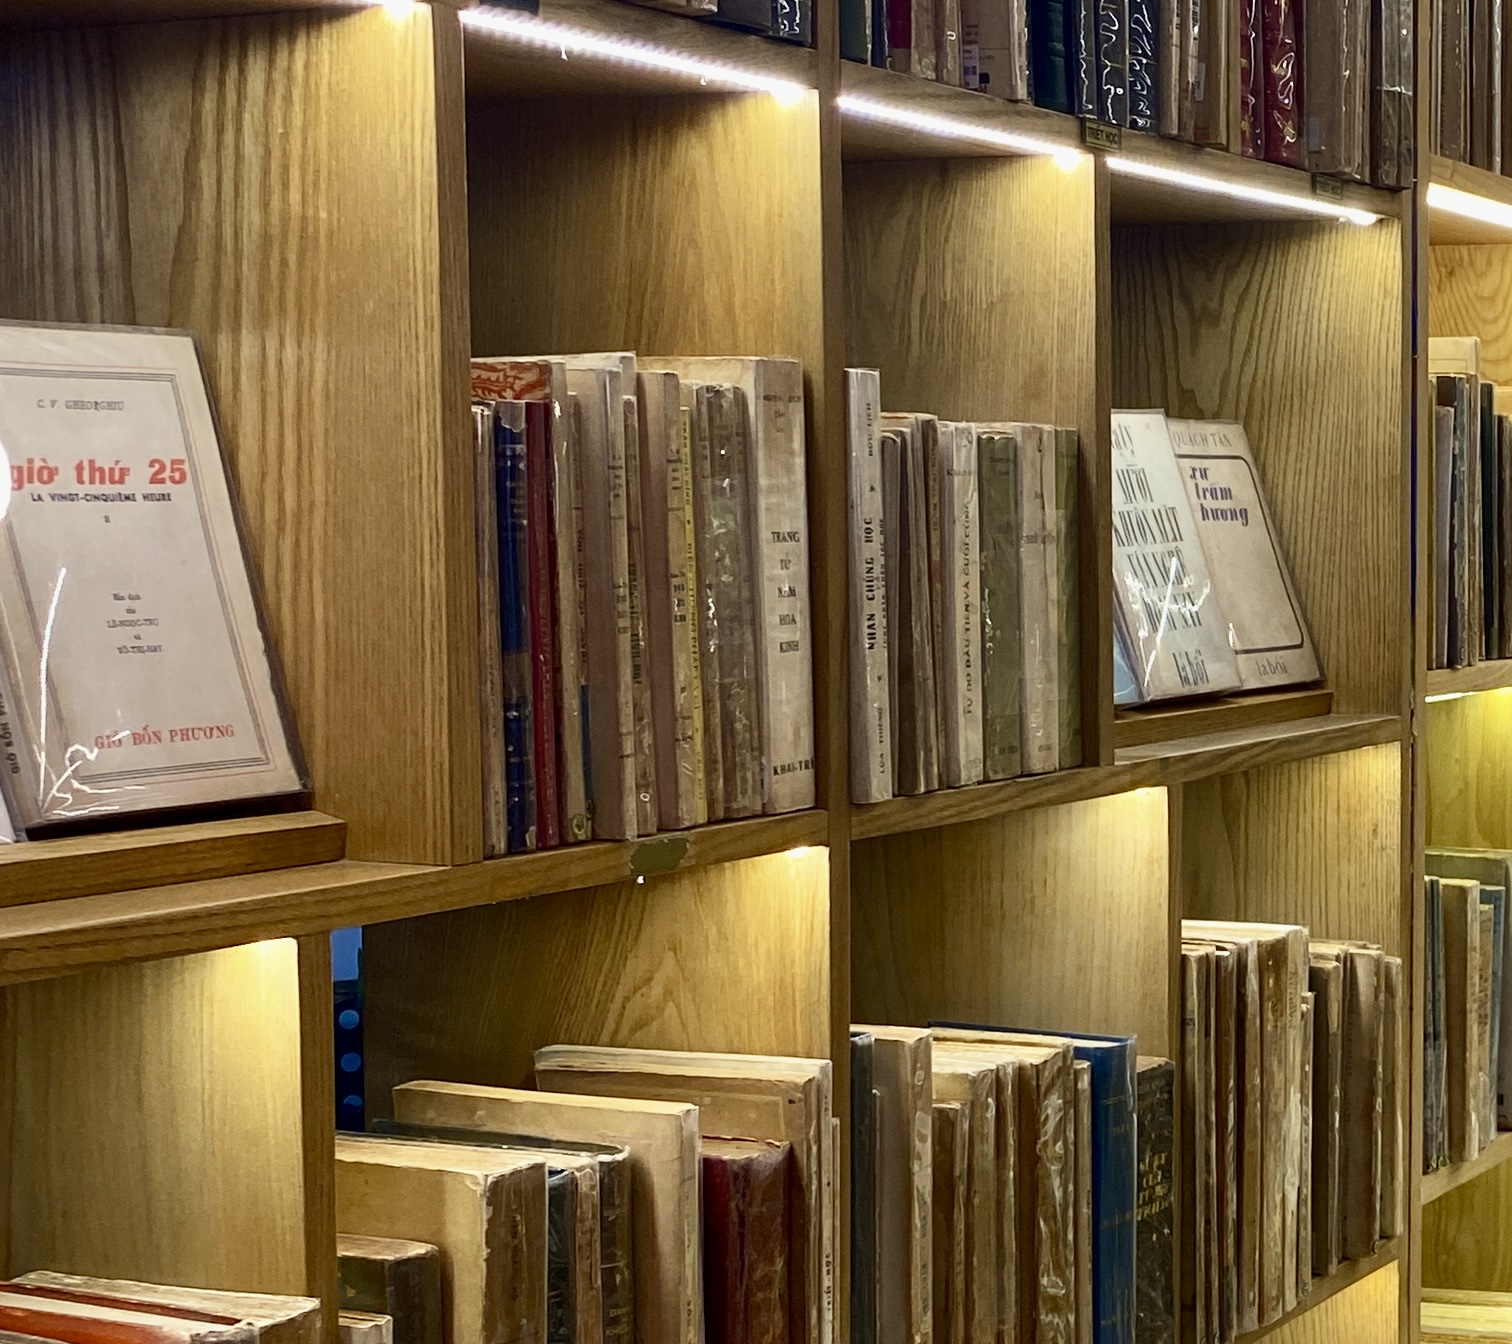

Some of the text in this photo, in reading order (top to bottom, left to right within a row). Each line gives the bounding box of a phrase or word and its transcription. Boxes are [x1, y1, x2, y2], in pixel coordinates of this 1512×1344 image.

[11, 458, 188, 492] giờ thứ 25
[31, 493, 44, 503] LA
[770, 529, 800, 545] TRANG
[863, 516, 873, 545] HỌC
[779, 613, 797, 626] HOA
[779, 640, 800, 654] KINH
[132, 723, 236, 747] BỐN PHƯƠNG
